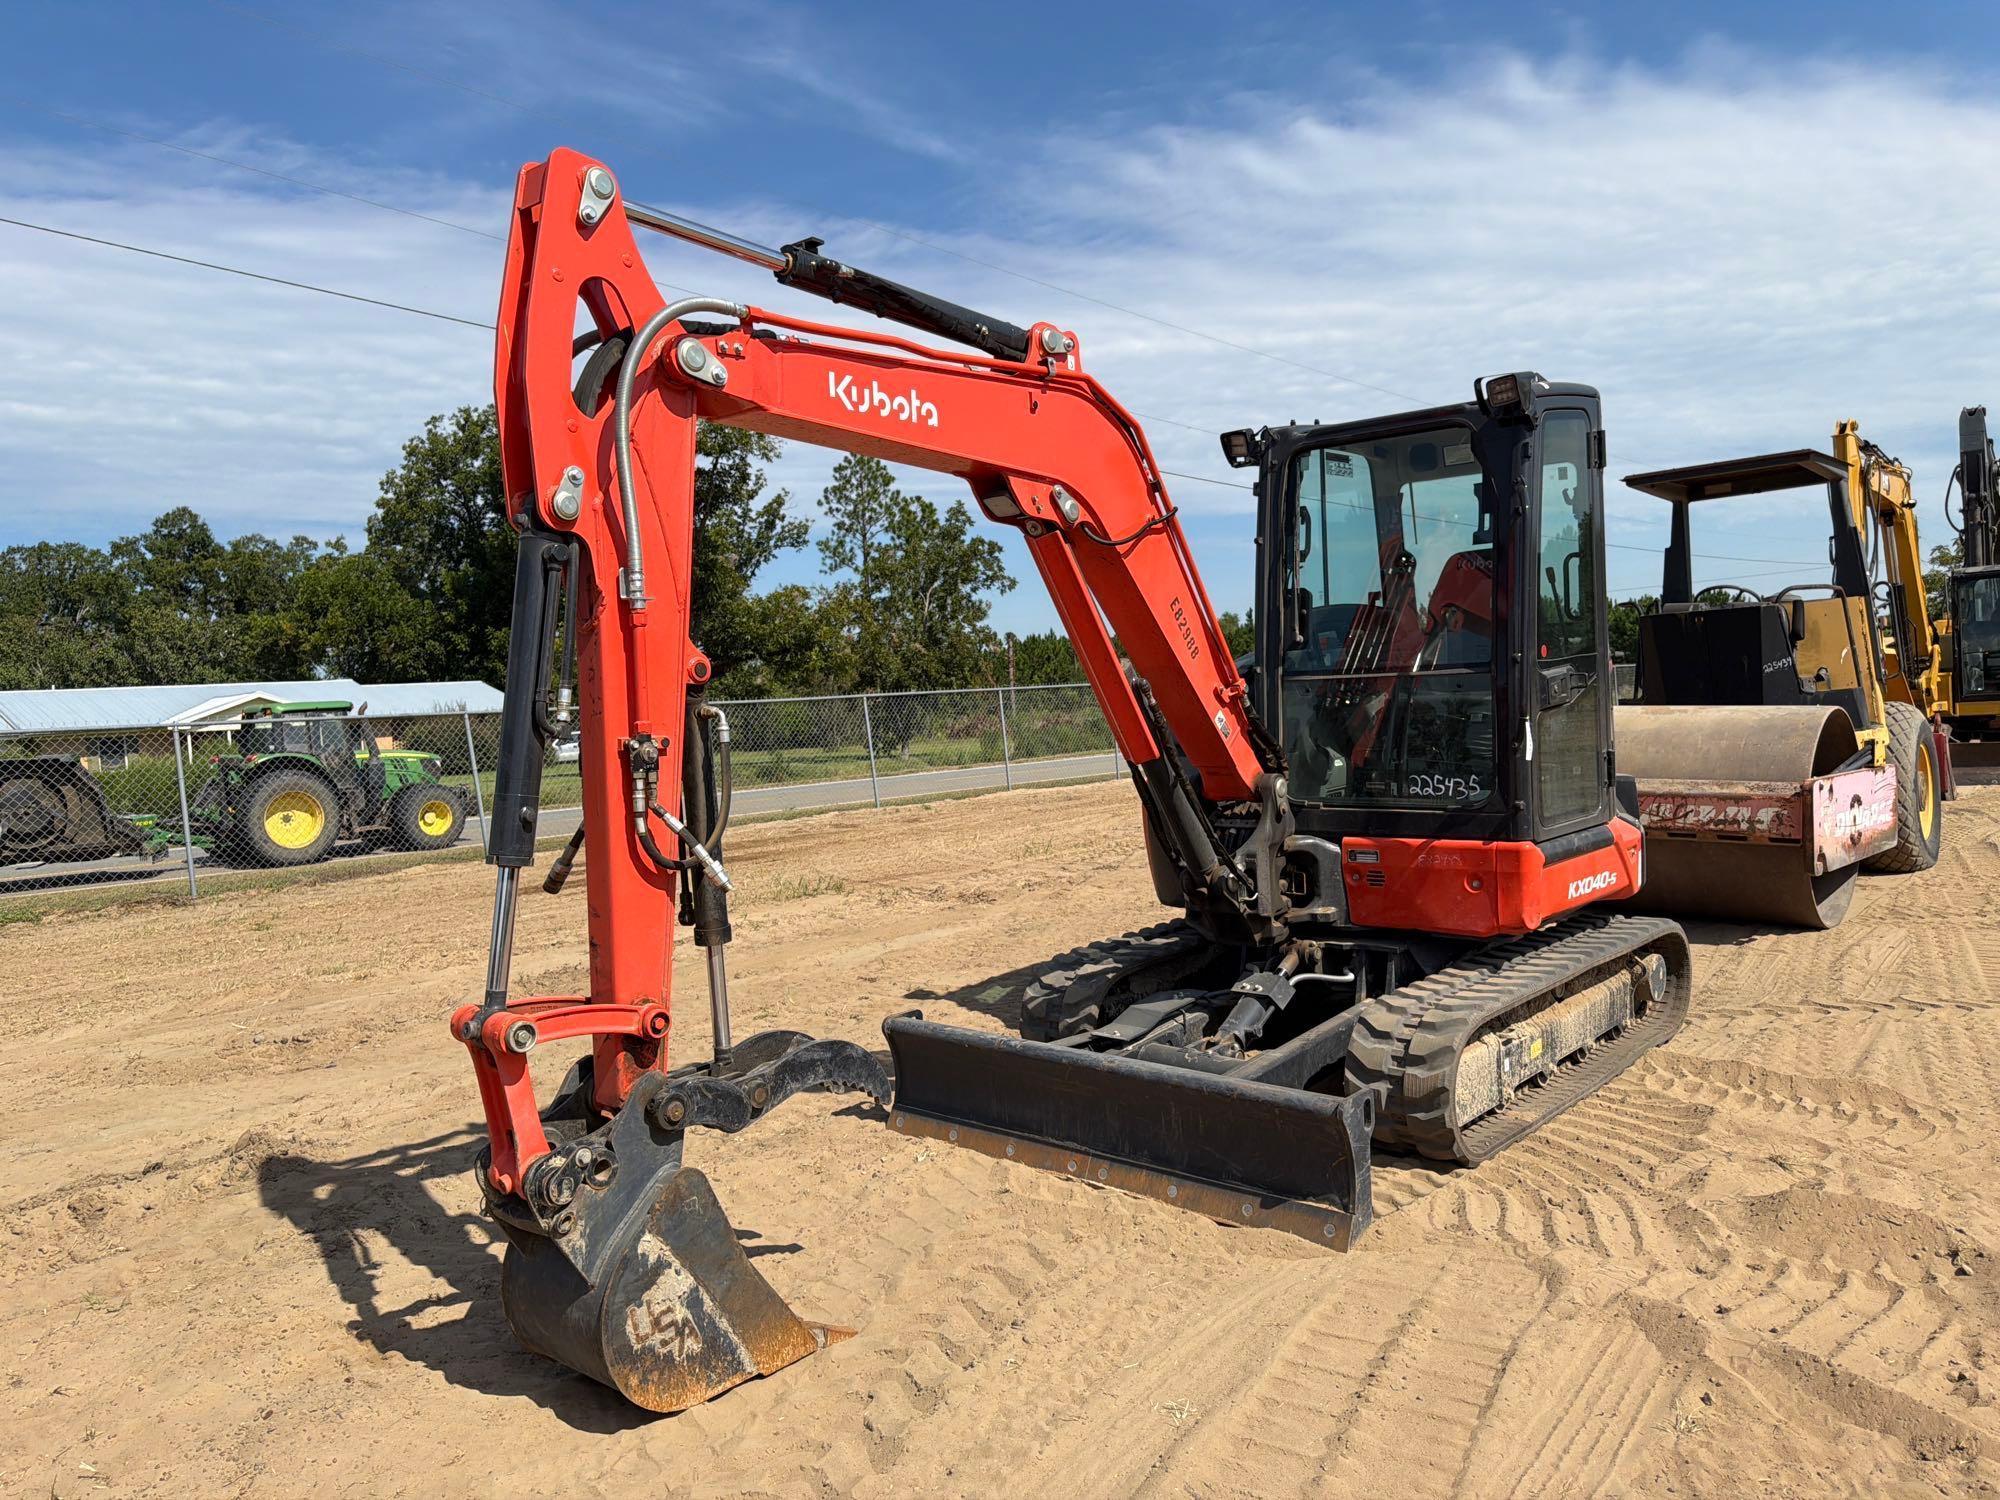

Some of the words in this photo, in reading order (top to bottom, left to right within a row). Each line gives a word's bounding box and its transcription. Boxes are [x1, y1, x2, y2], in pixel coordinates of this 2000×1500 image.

[828, 370, 938, 427] Kubota
[1170, 596, 1200, 660] E82988
[1409, 774, 1480, 800] 225435
